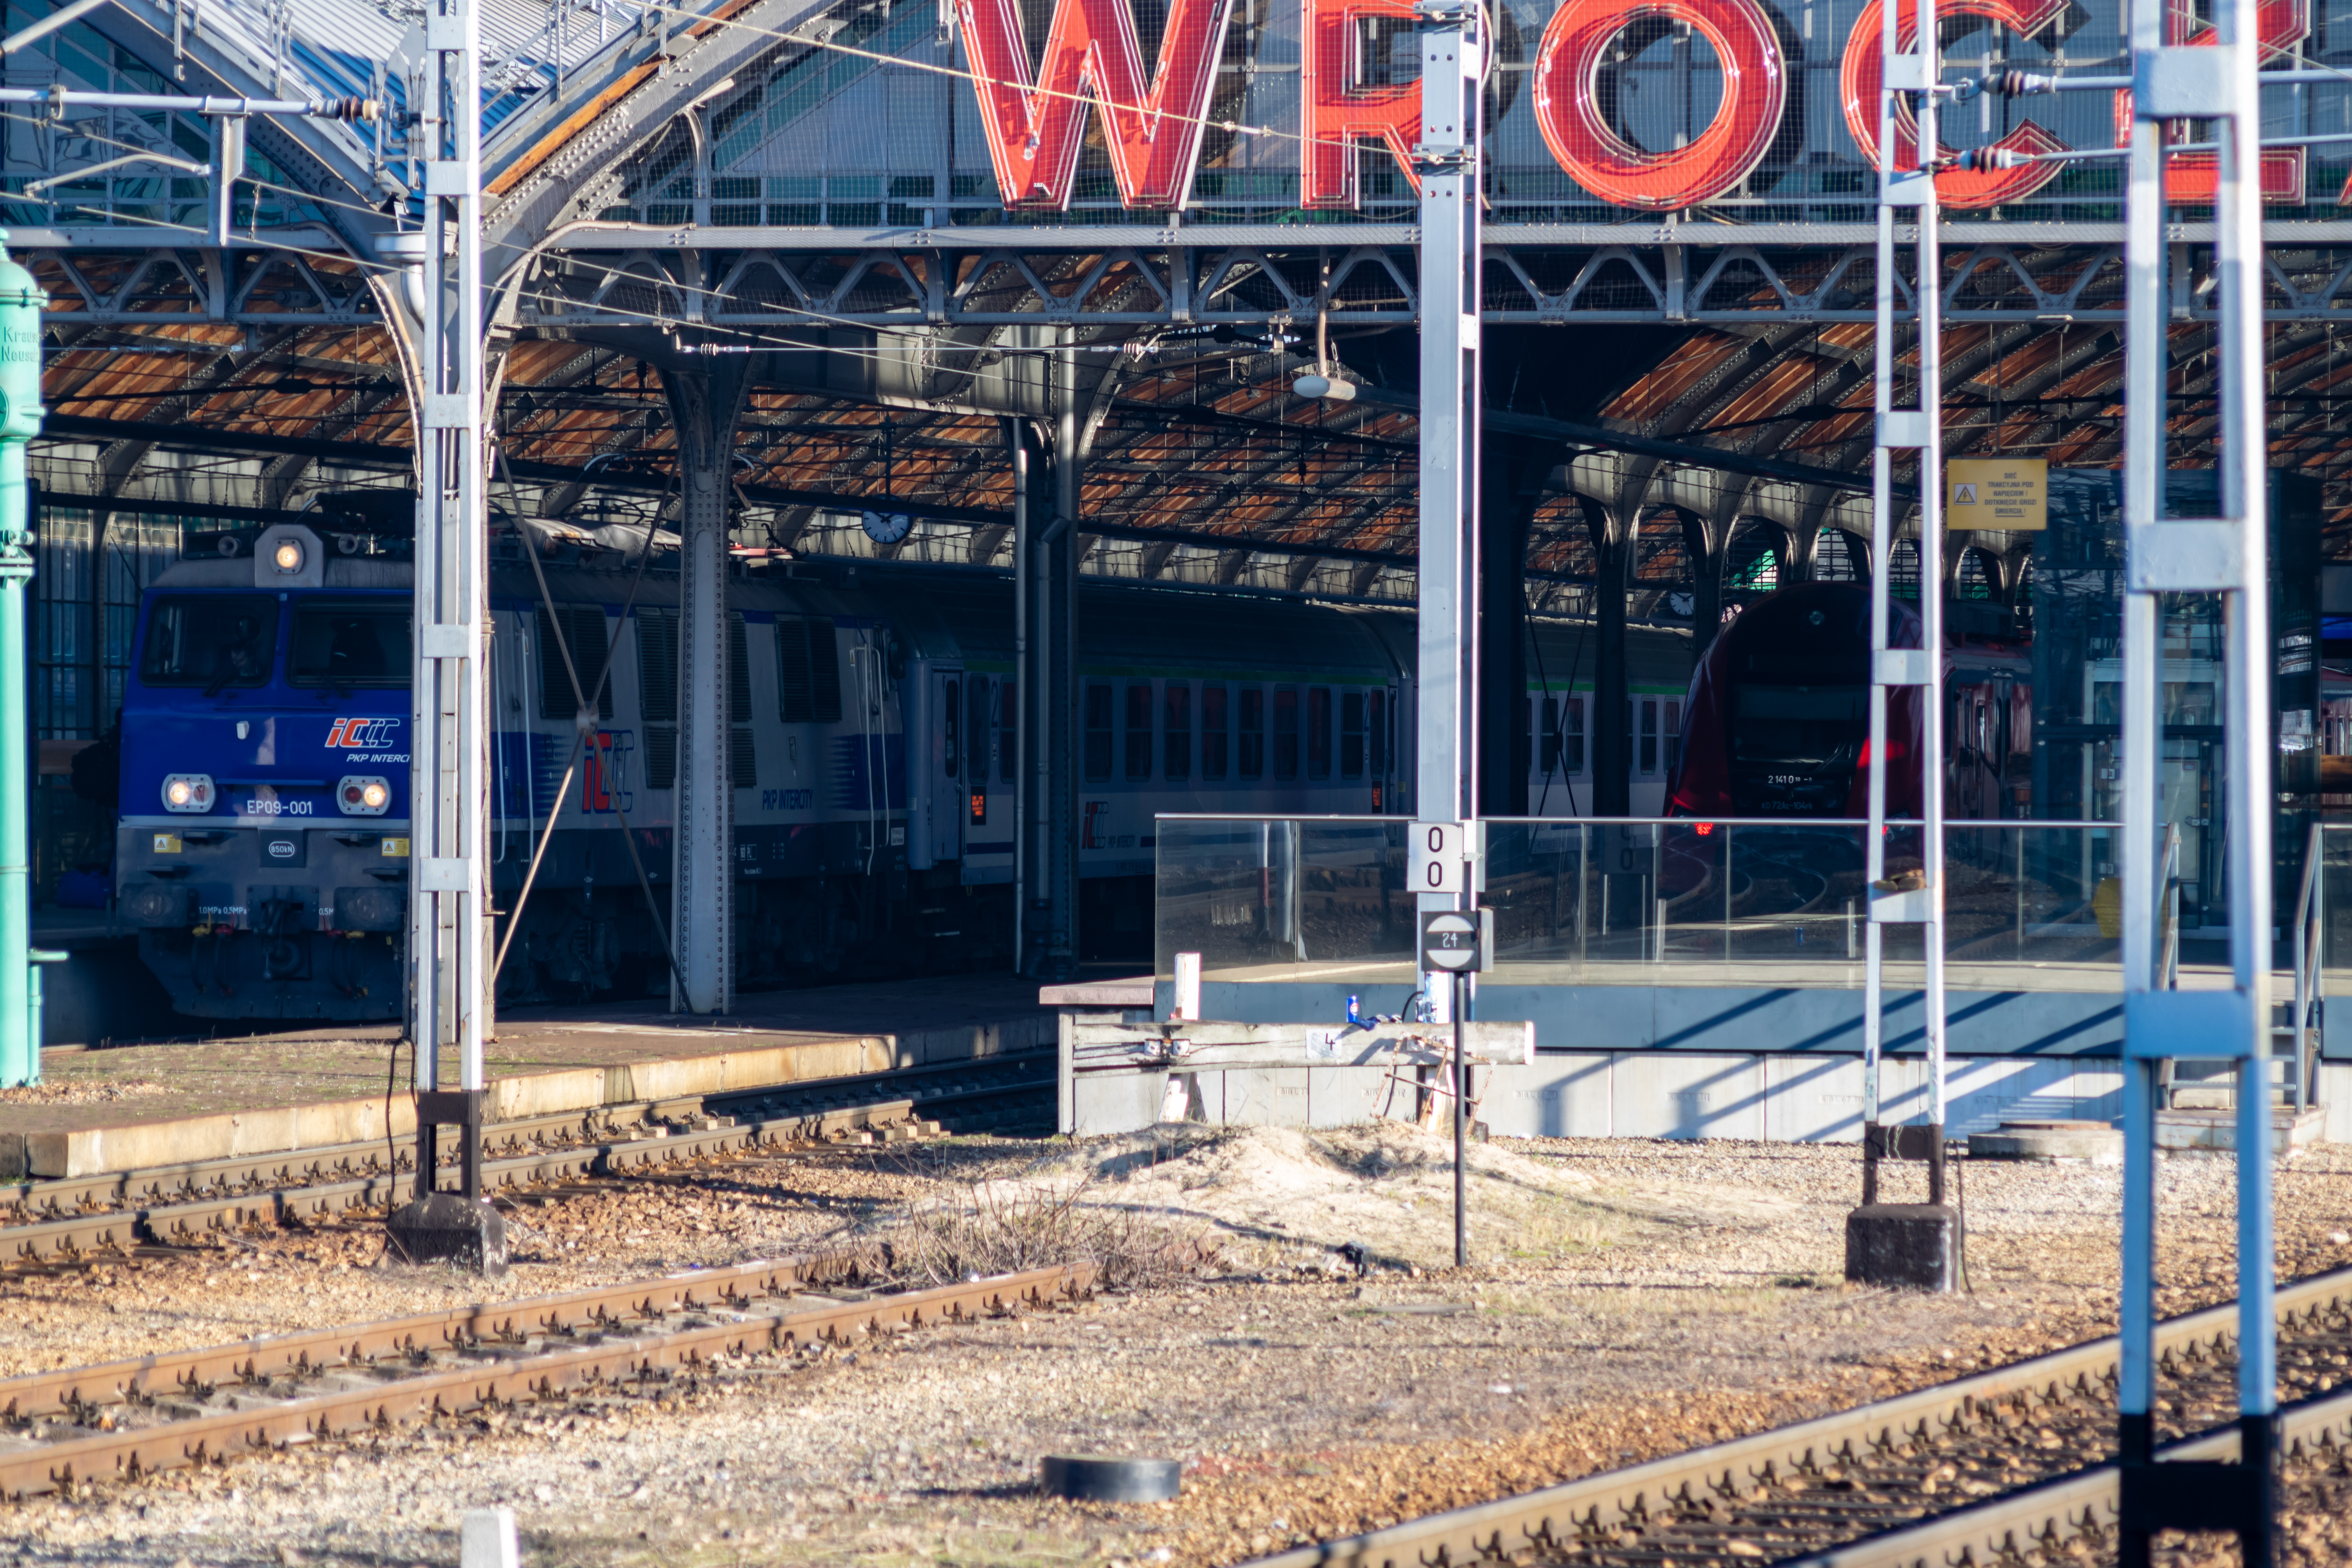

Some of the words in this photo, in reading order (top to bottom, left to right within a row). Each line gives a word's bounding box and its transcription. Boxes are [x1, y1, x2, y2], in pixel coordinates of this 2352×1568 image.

[991, 680, 998, 728] 2
[1364, 692, 1369, 732] 2
[346, 754, 369, 762] PKP
[370, 754, 410, 762] INTERCI
[247, 800, 312, 814] EP09-001
[762, 789, 777, 810] PKP
[779, 789, 813, 810] INTERCITY
[1428, 827, 1443, 853] 0
[1428, 861, 1442, 887] 0
[1443, 933, 1457, 947] 24
[1325, 1033, 1336, 1051] 4
